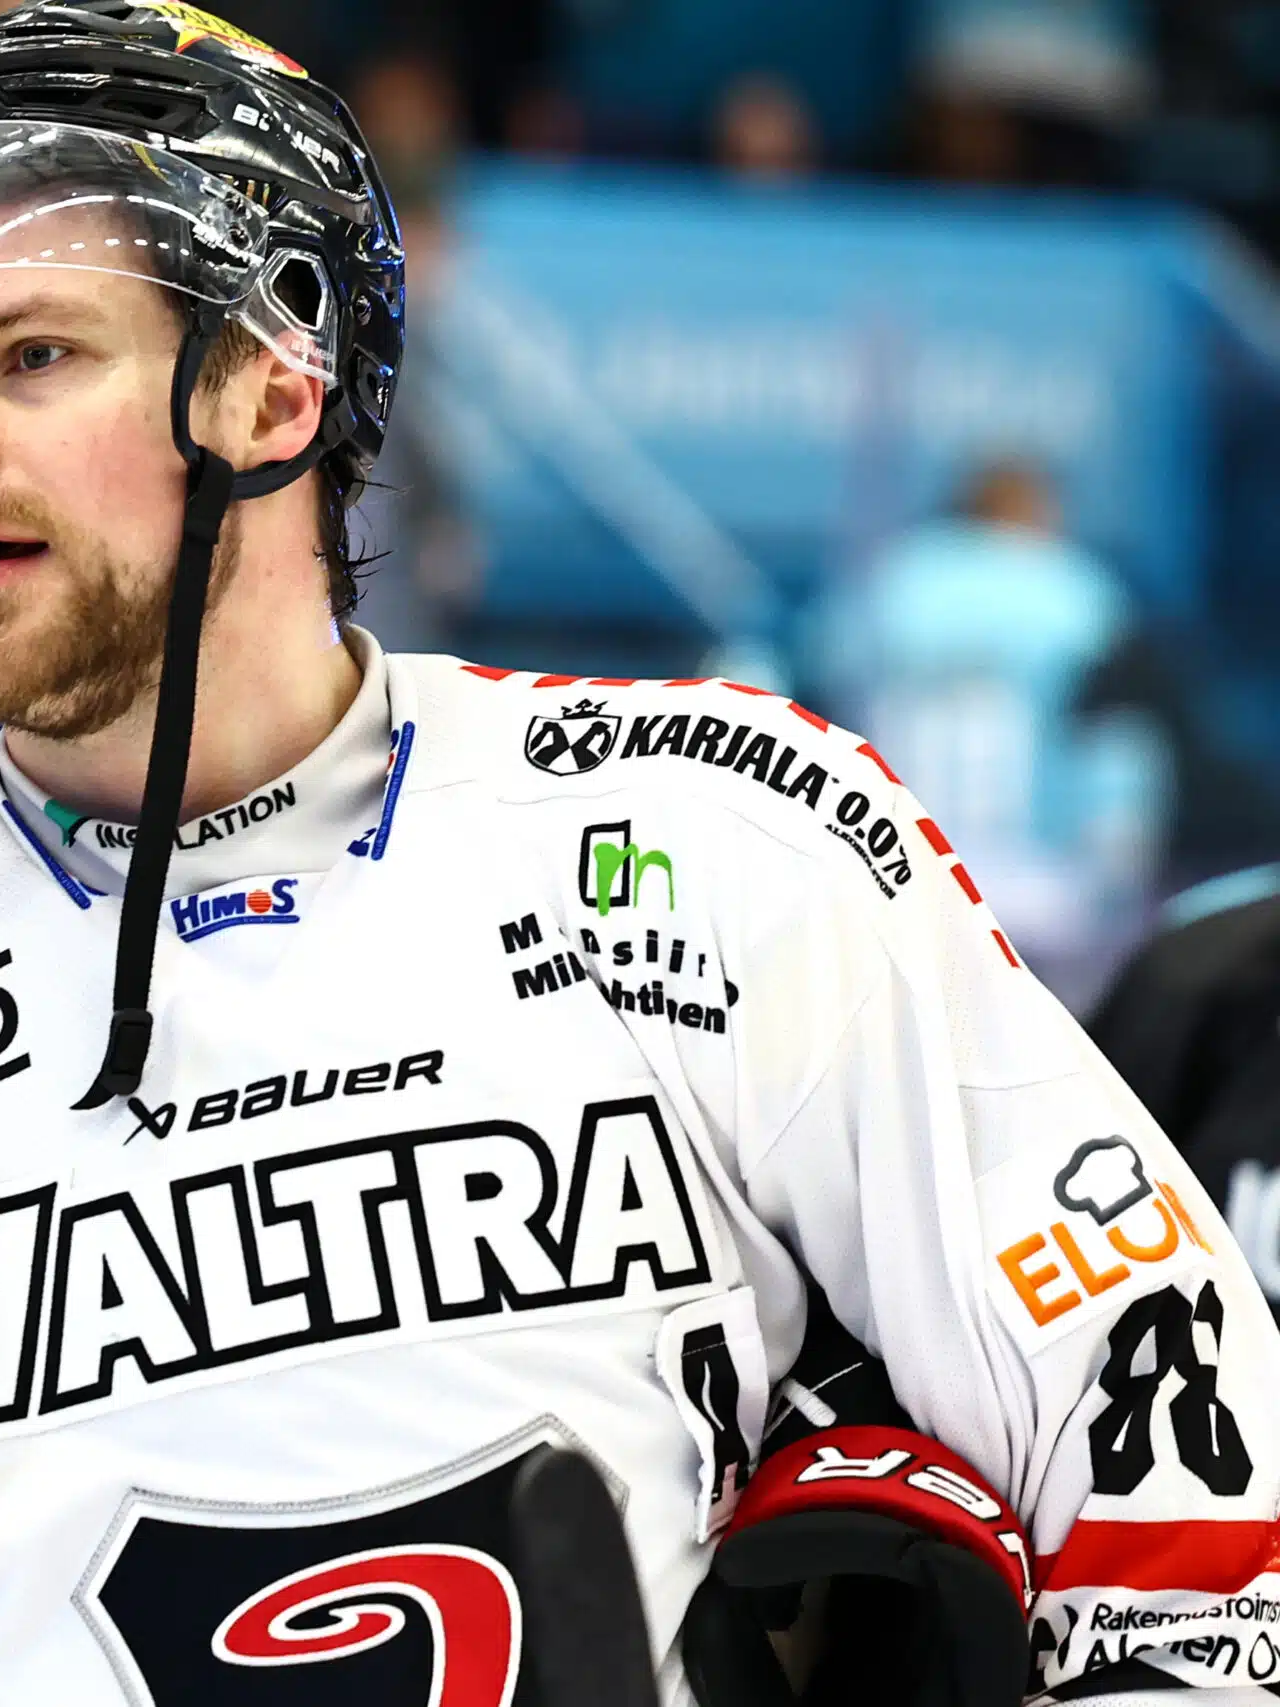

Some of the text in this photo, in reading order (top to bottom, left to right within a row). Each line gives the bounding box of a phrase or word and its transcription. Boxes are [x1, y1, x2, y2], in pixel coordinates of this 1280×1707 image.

[232, 103, 340, 174] BER
[620, 714, 829, 809] KARJALA
[95, 781, 297, 850] INSLATION
[187, 1049, 445, 1132] BAUER
